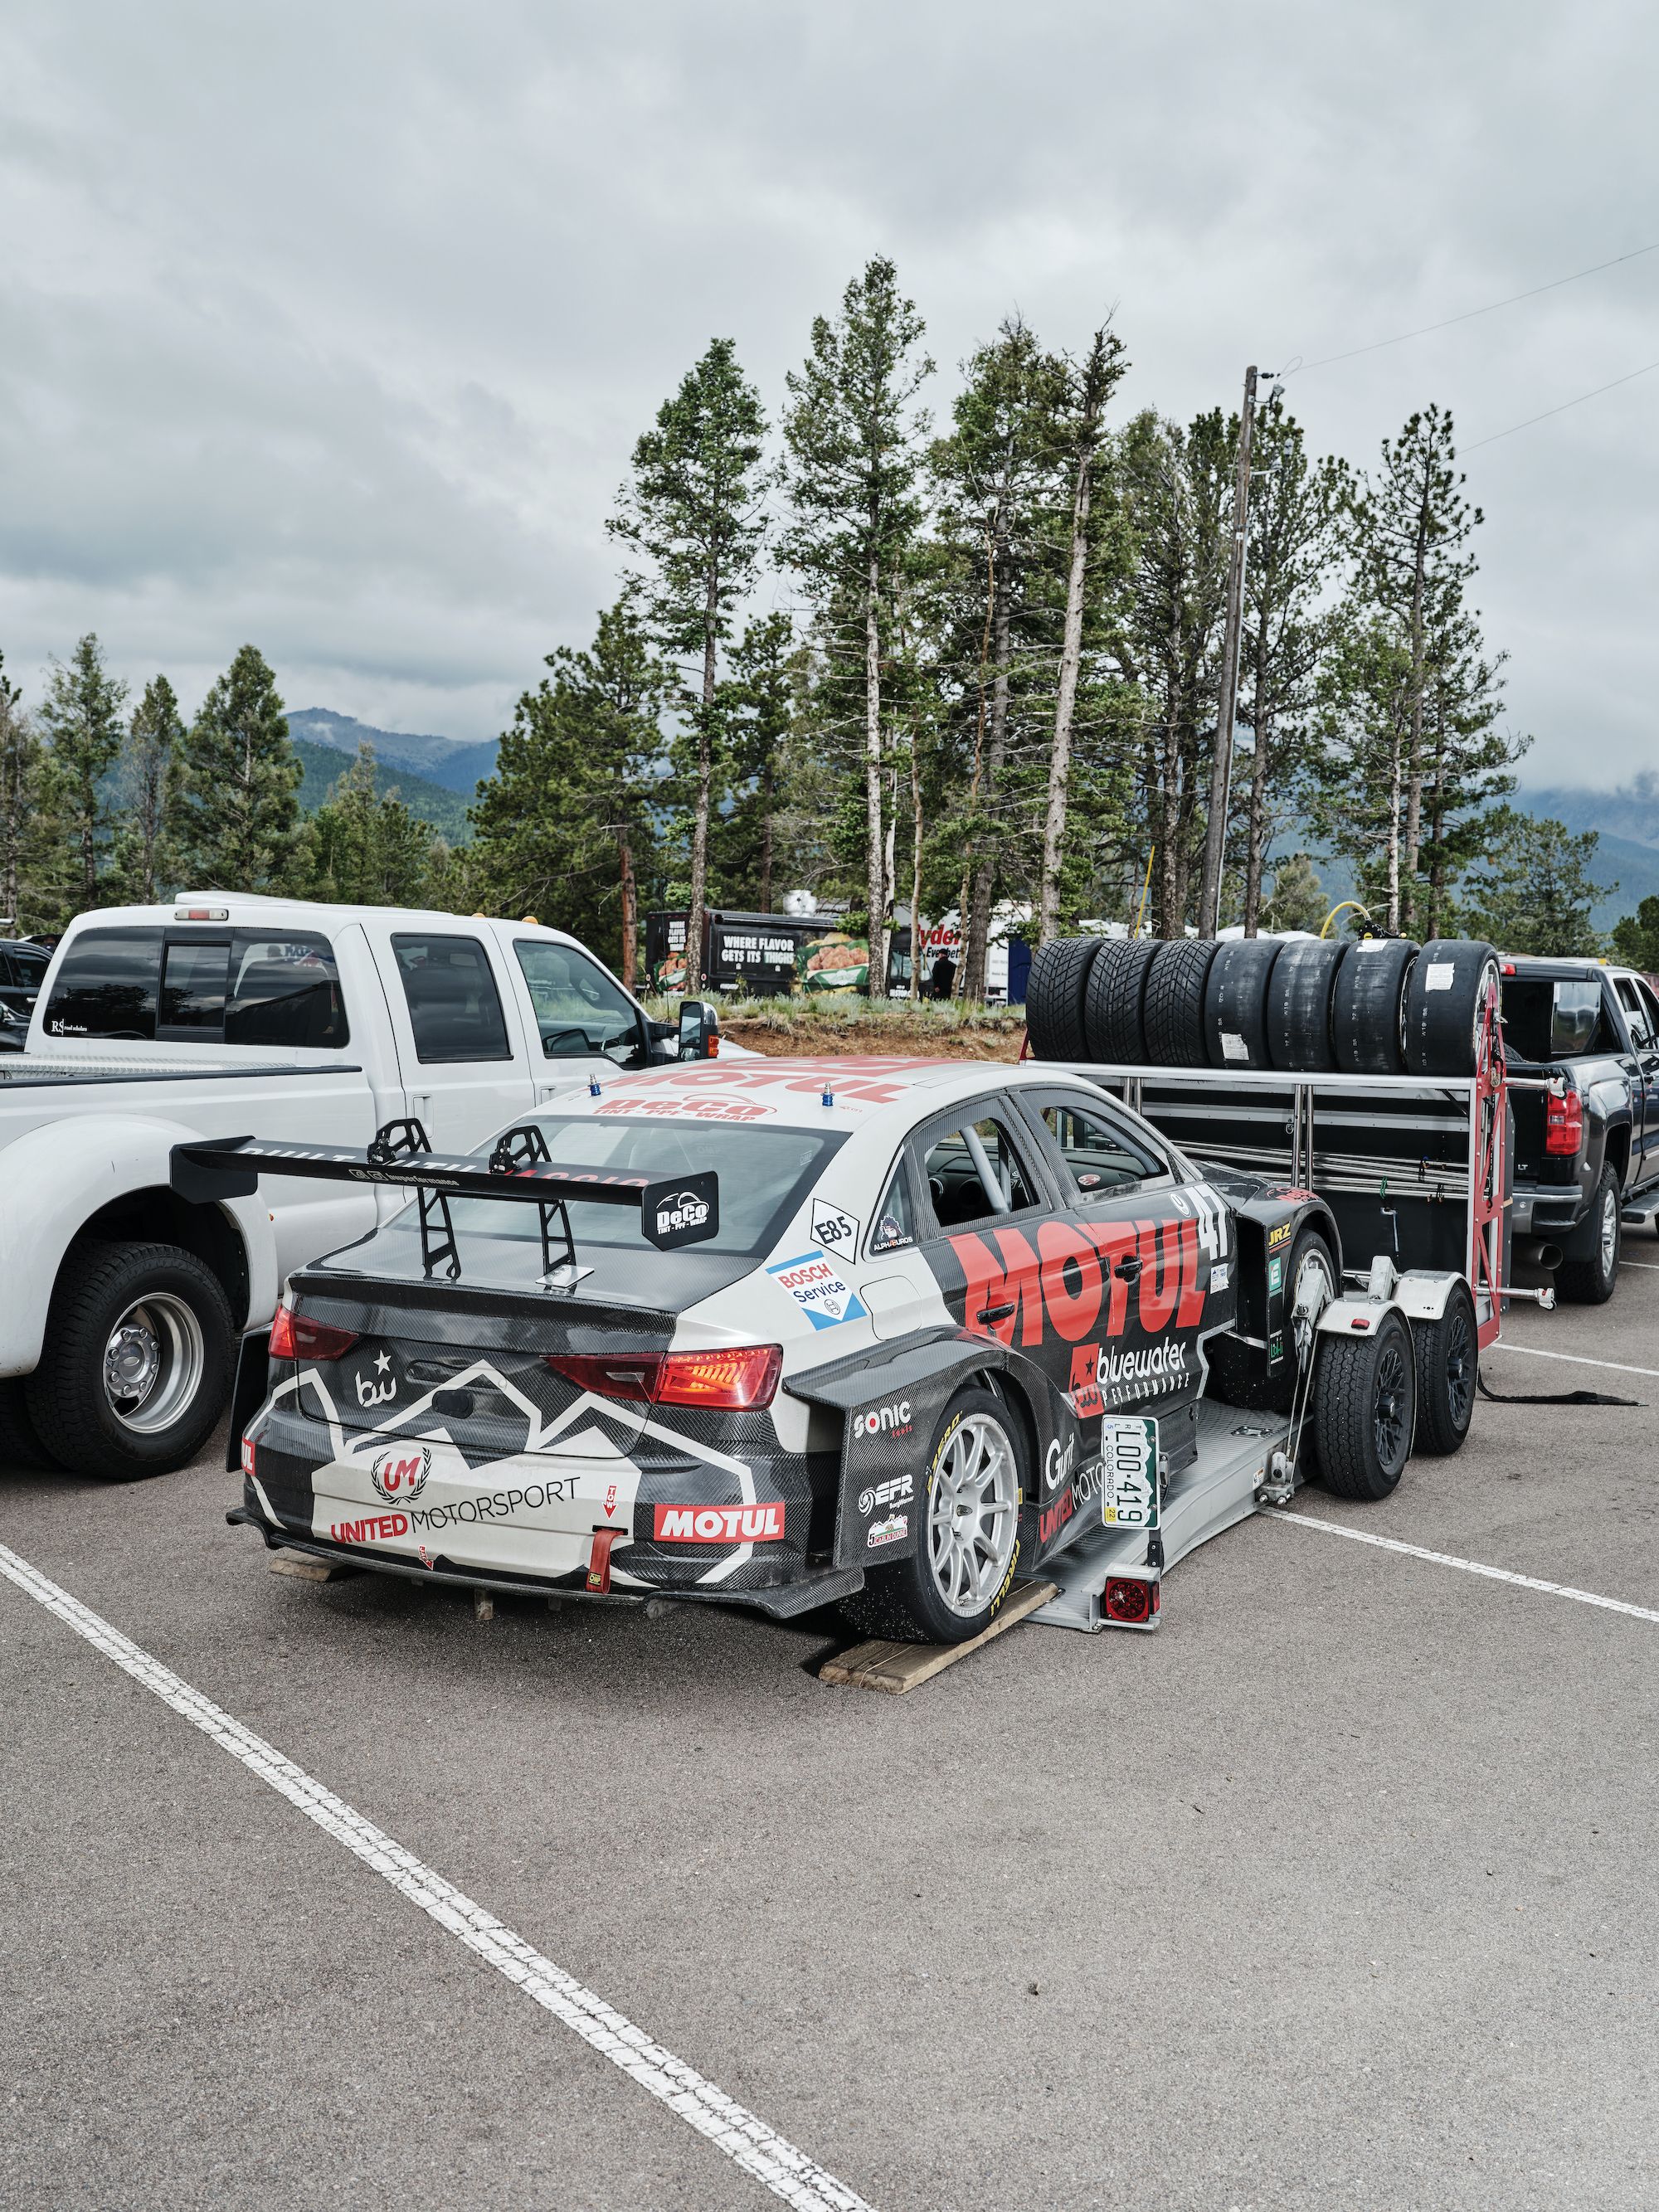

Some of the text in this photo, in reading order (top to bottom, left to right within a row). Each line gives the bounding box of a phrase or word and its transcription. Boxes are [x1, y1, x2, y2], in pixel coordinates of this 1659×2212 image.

[723, 936, 794, 951] WHERE FLAVOR
[927, 947, 942, 958] Eve
[721, 949, 794, 965] GETS ITS THIGHS
[597, 1099, 768, 1116] DeCo
[694, 1112, 757, 1121] WRAP
[657, 1204, 708, 1228] DeCo
[657, 1217, 708, 1235] TINT PPF WRAP
[1184, 1184, 1228, 1261] 47
[815, 1216, 852, 1244] E85
[1269, 1223, 1291, 1247] JRZ
[778, 1263, 834, 1289] BOSCH
[948, 1219, 1206, 1347] MOTUL
[793, 1281, 846, 1303] Service
[1097, 1336, 1186, 1384] bluewater
[1101, 1373, 1190, 1406] PERFORMANCE
[1106, 1445, 1114, 1499] COLORADO
[606, 1487, 616, 1509] TOW
[875, 1474, 913, 1505] EFR
[331, 1476, 581, 1544] UNITED MOTORSPORT
[1108, 1509, 1117, 1519] 22
[660, 1508, 781, 1539] MOTUL
[990, 1539, 1020, 1617] PIRELLI
